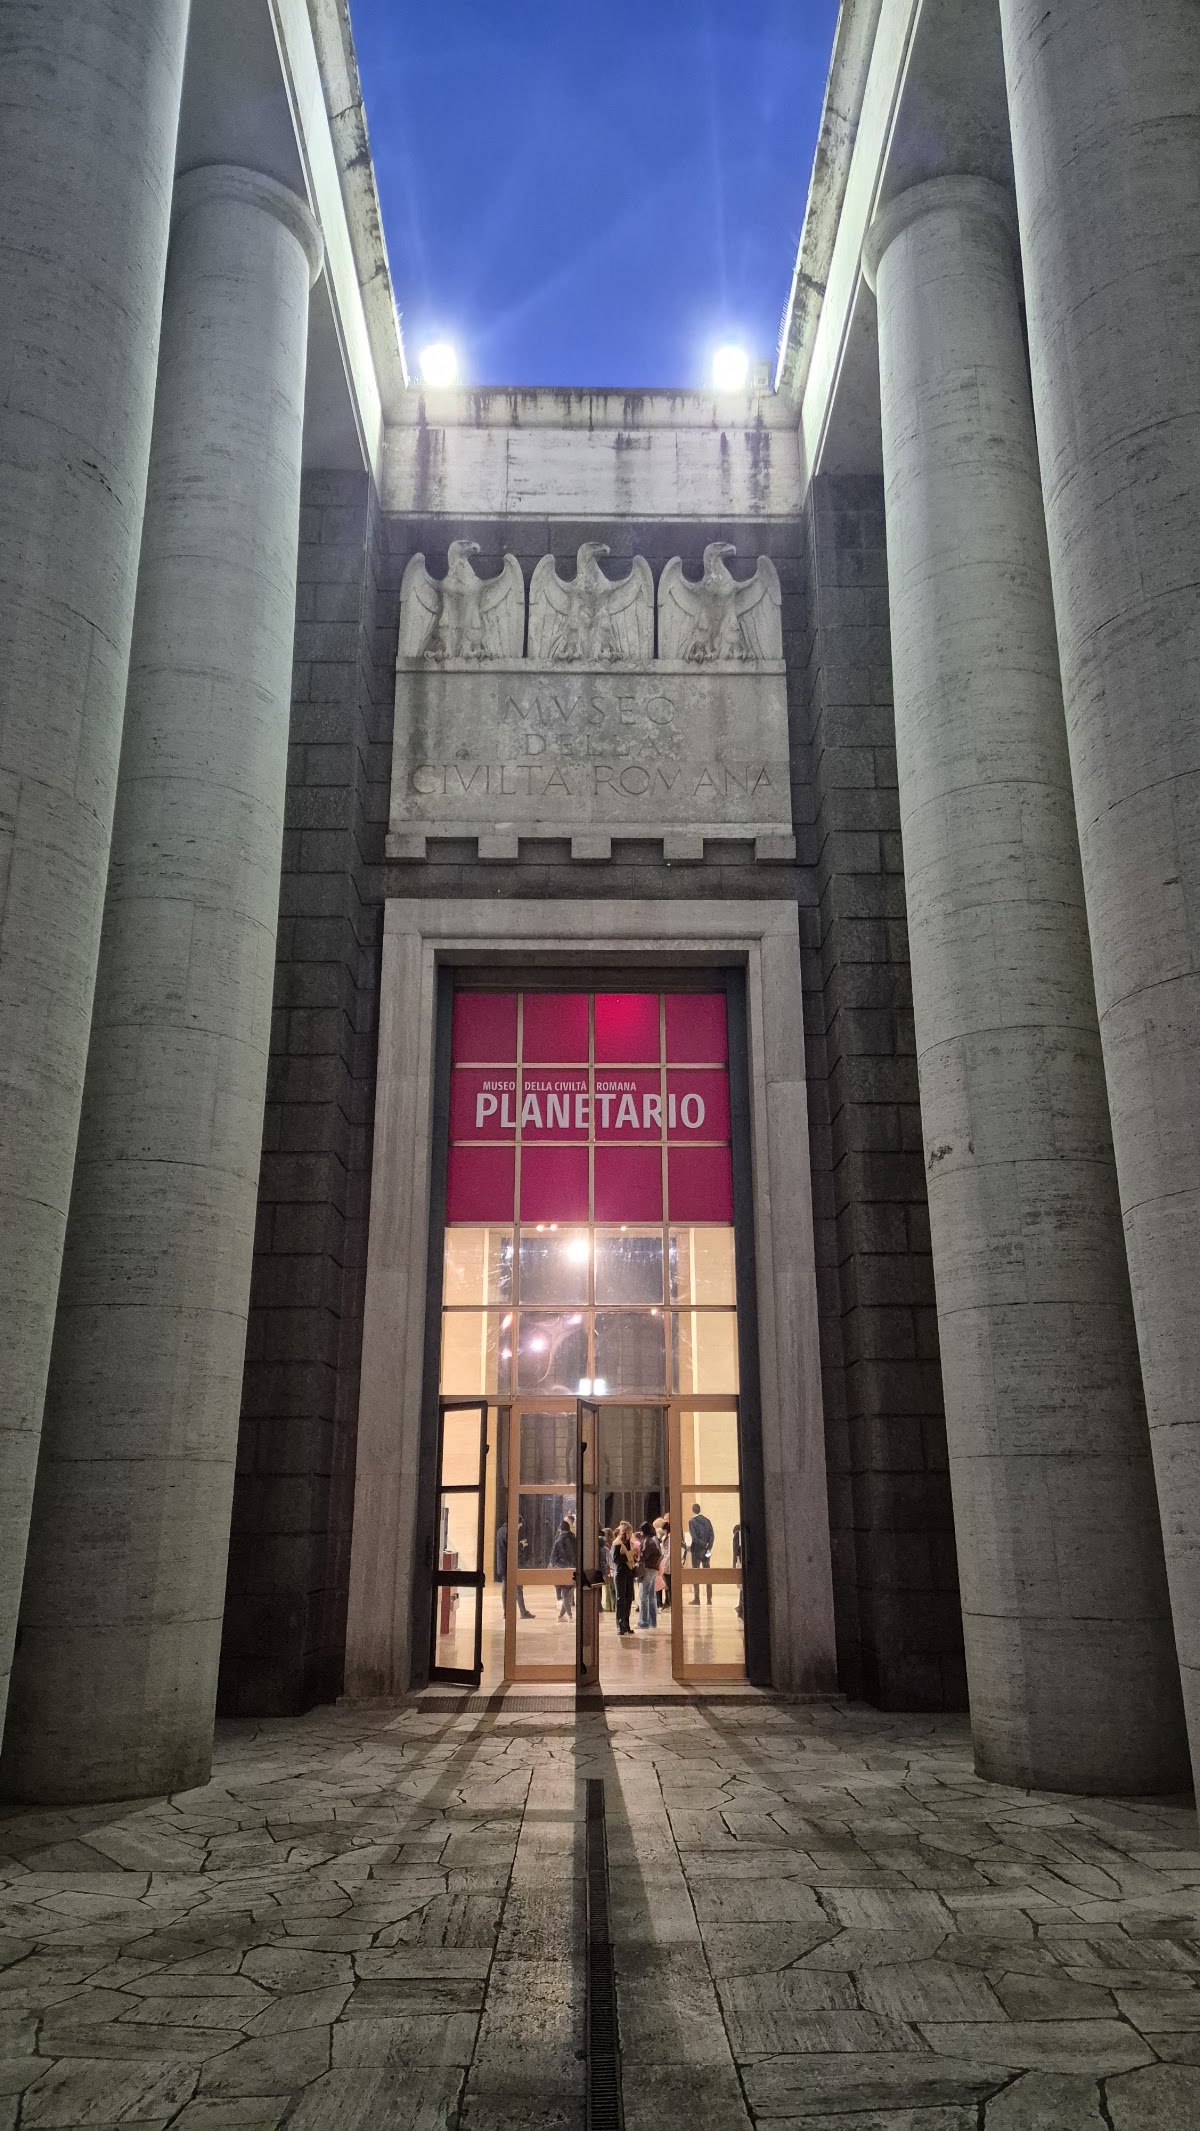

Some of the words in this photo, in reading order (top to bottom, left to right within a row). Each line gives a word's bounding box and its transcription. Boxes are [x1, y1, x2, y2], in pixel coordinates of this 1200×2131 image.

[504, 696, 676, 725] MVSEO
[523, 733, 664, 757] DELLA
[592, 765, 776, 797] ROMANA
[482, 1081, 516, 1091] MUSEO
[524, 1081, 552, 1091] DELLA
[554, 1080, 587, 1091] CIVILTÀ
[596, 1081, 637, 1091] ROMANA
[475, 1093, 706, 1129] PLANETARIO
